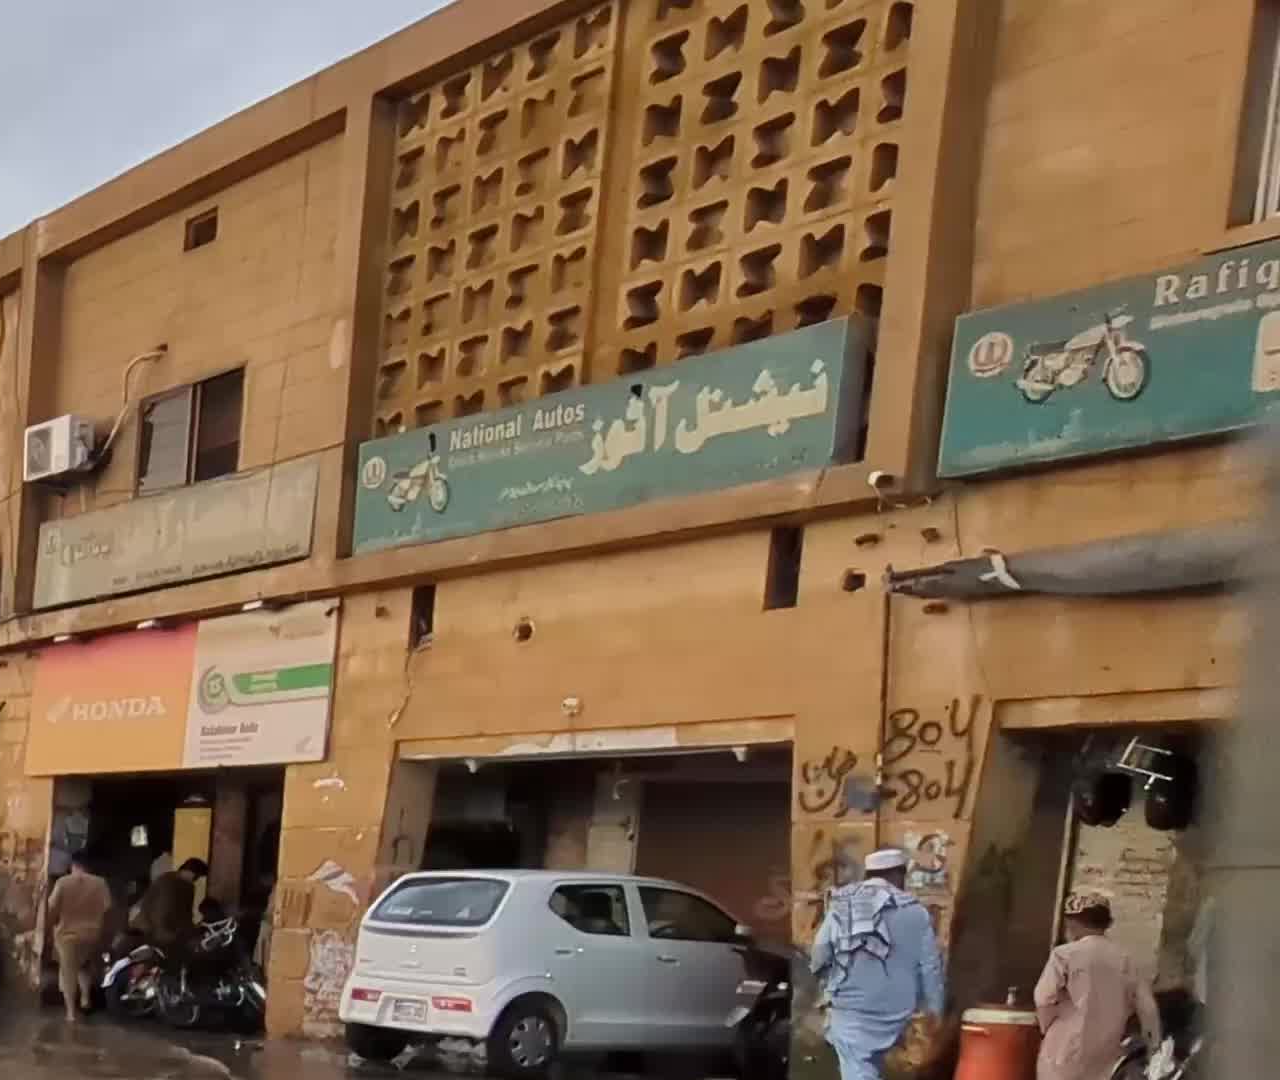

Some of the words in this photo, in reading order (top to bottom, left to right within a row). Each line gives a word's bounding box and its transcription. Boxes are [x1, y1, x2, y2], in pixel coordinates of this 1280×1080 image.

[449, 414, 522, 452] National
[532, 403, 585, 432] Autos
[72, 695, 167, 722] HONDA
